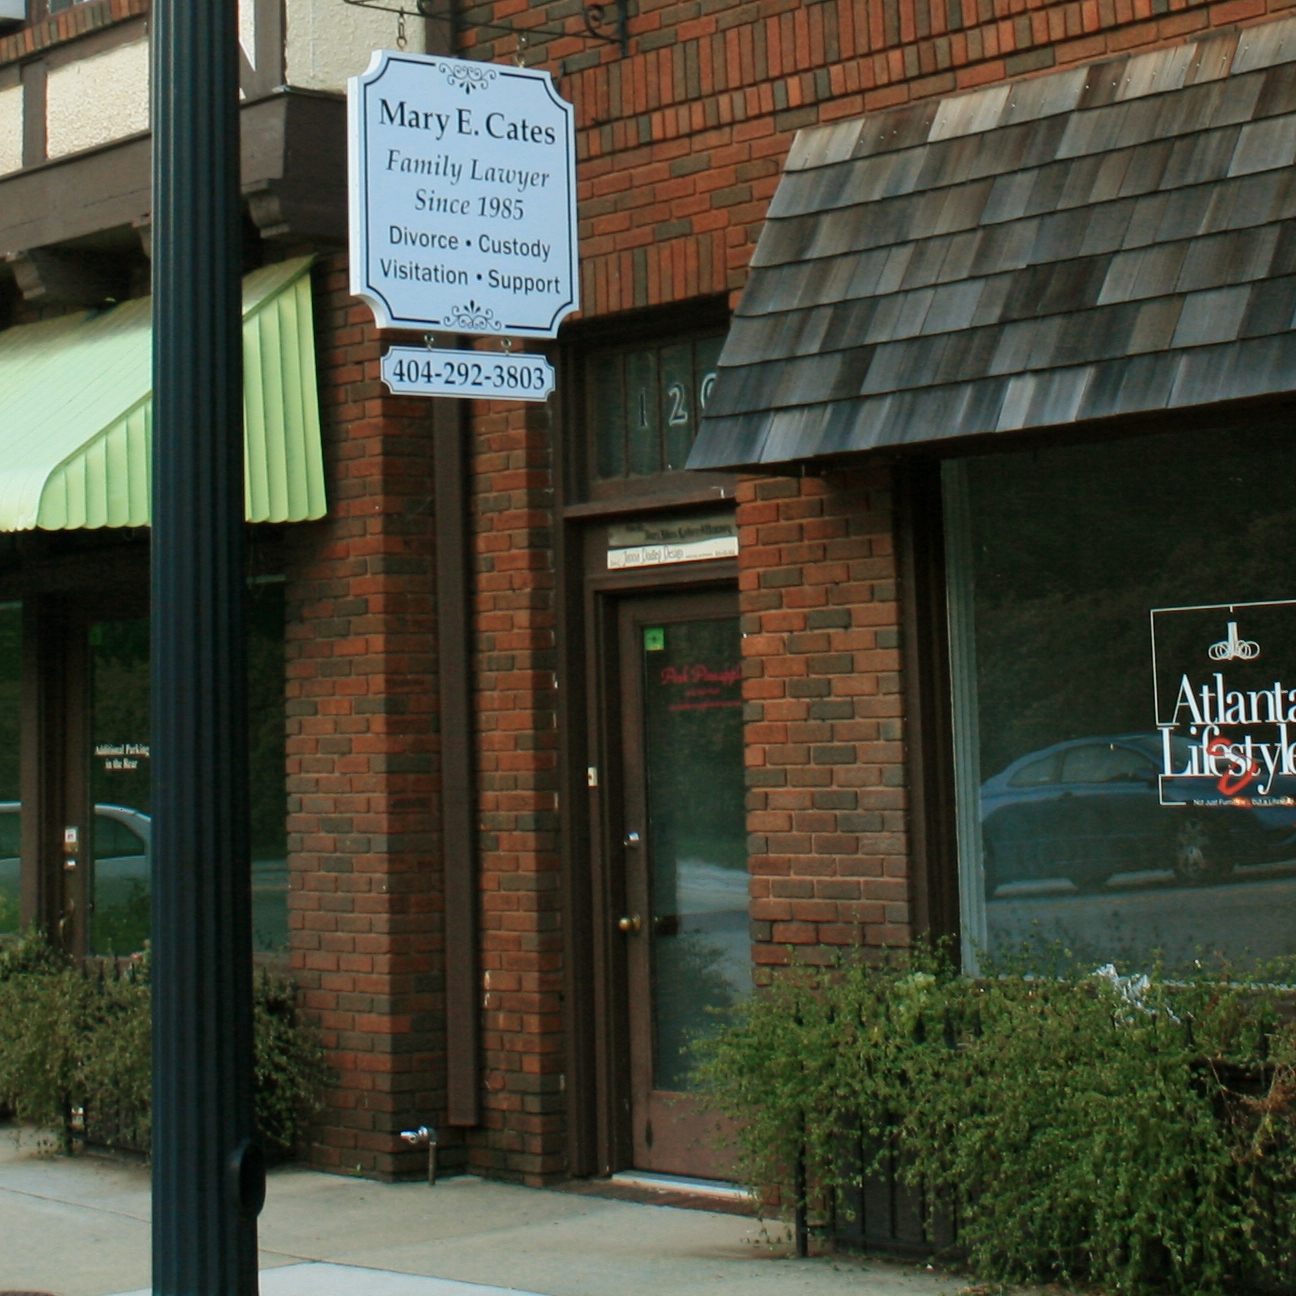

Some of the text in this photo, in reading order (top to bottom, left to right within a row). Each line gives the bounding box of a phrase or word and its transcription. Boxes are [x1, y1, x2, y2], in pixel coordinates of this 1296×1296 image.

[378, 97, 556, 145] Mary E. Cates
[385, 149, 550, 193] Family Lawyer
[413, 187, 525, 221] Since 1985
[389, 225, 551, 263] Divorce Custody
[379, 258, 561, 296] Visitation Support
[391, 358, 546, 390] 404-292-3803
[125, 743, 150, 757] Parking
